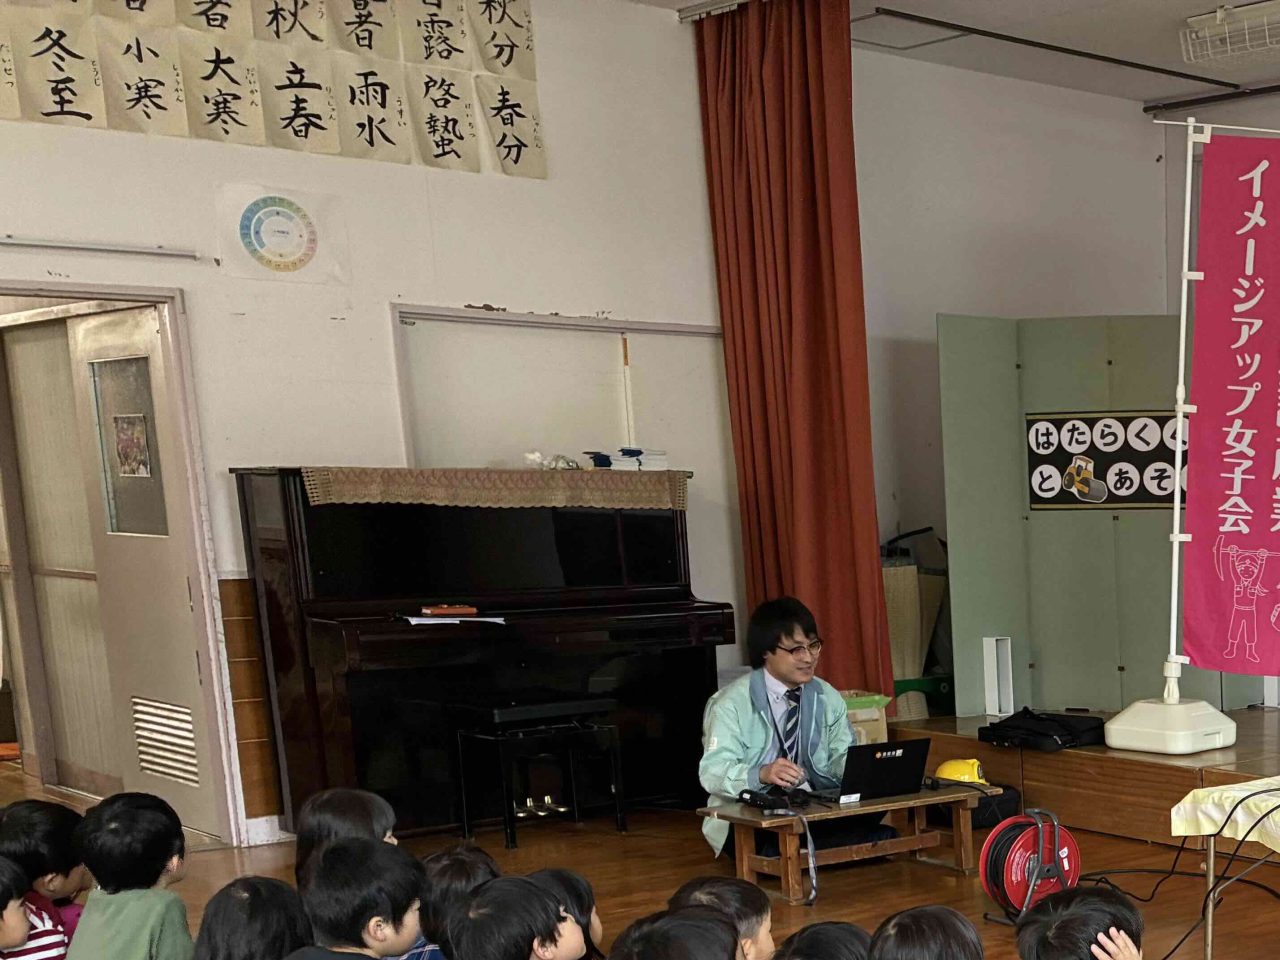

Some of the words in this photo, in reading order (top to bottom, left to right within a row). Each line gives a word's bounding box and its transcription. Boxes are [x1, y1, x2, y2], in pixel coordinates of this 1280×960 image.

[29, 26, 93, 121] 冬至
[121, 36, 168, 120] 小寒
[200, 46, 248, 136] 大寒
[274, 61, 328, 139] 立春
[349, 70, 396, 148] 雨水
[490, 85, 528, 165] 春分
[1217, 159, 1270, 535] イメージアップ女子会
[1038, 470, 1056, 493] と
